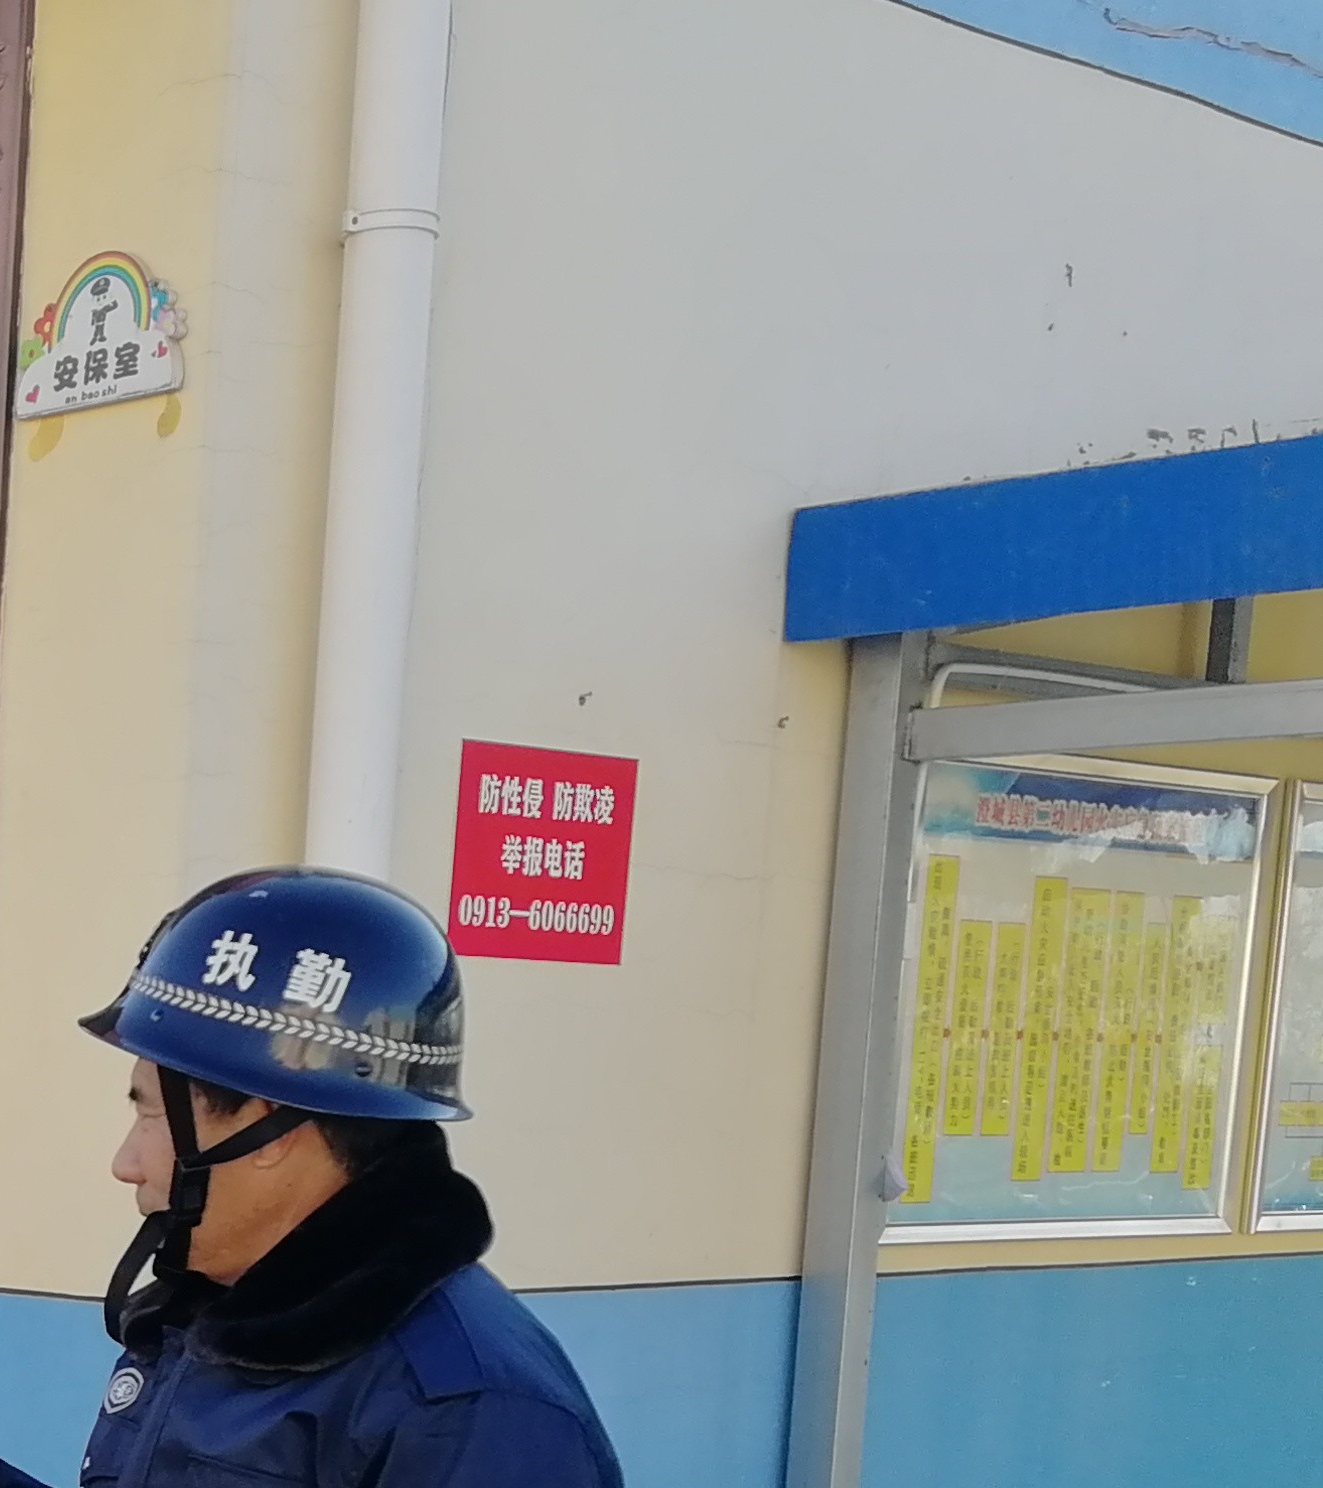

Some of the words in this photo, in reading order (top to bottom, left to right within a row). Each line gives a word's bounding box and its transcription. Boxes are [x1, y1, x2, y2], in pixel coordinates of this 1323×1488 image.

[53, 341, 140, 392] 安保室
[65, 396, 78, 405] an
[81, 391, 101, 401] bao
[477, 774, 544, 819] 防性侵
[551, 781, 615, 825] 防欺凌
[500, 834, 586, 880] 举报电话
[201, 929, 353, 1013] 执勤
